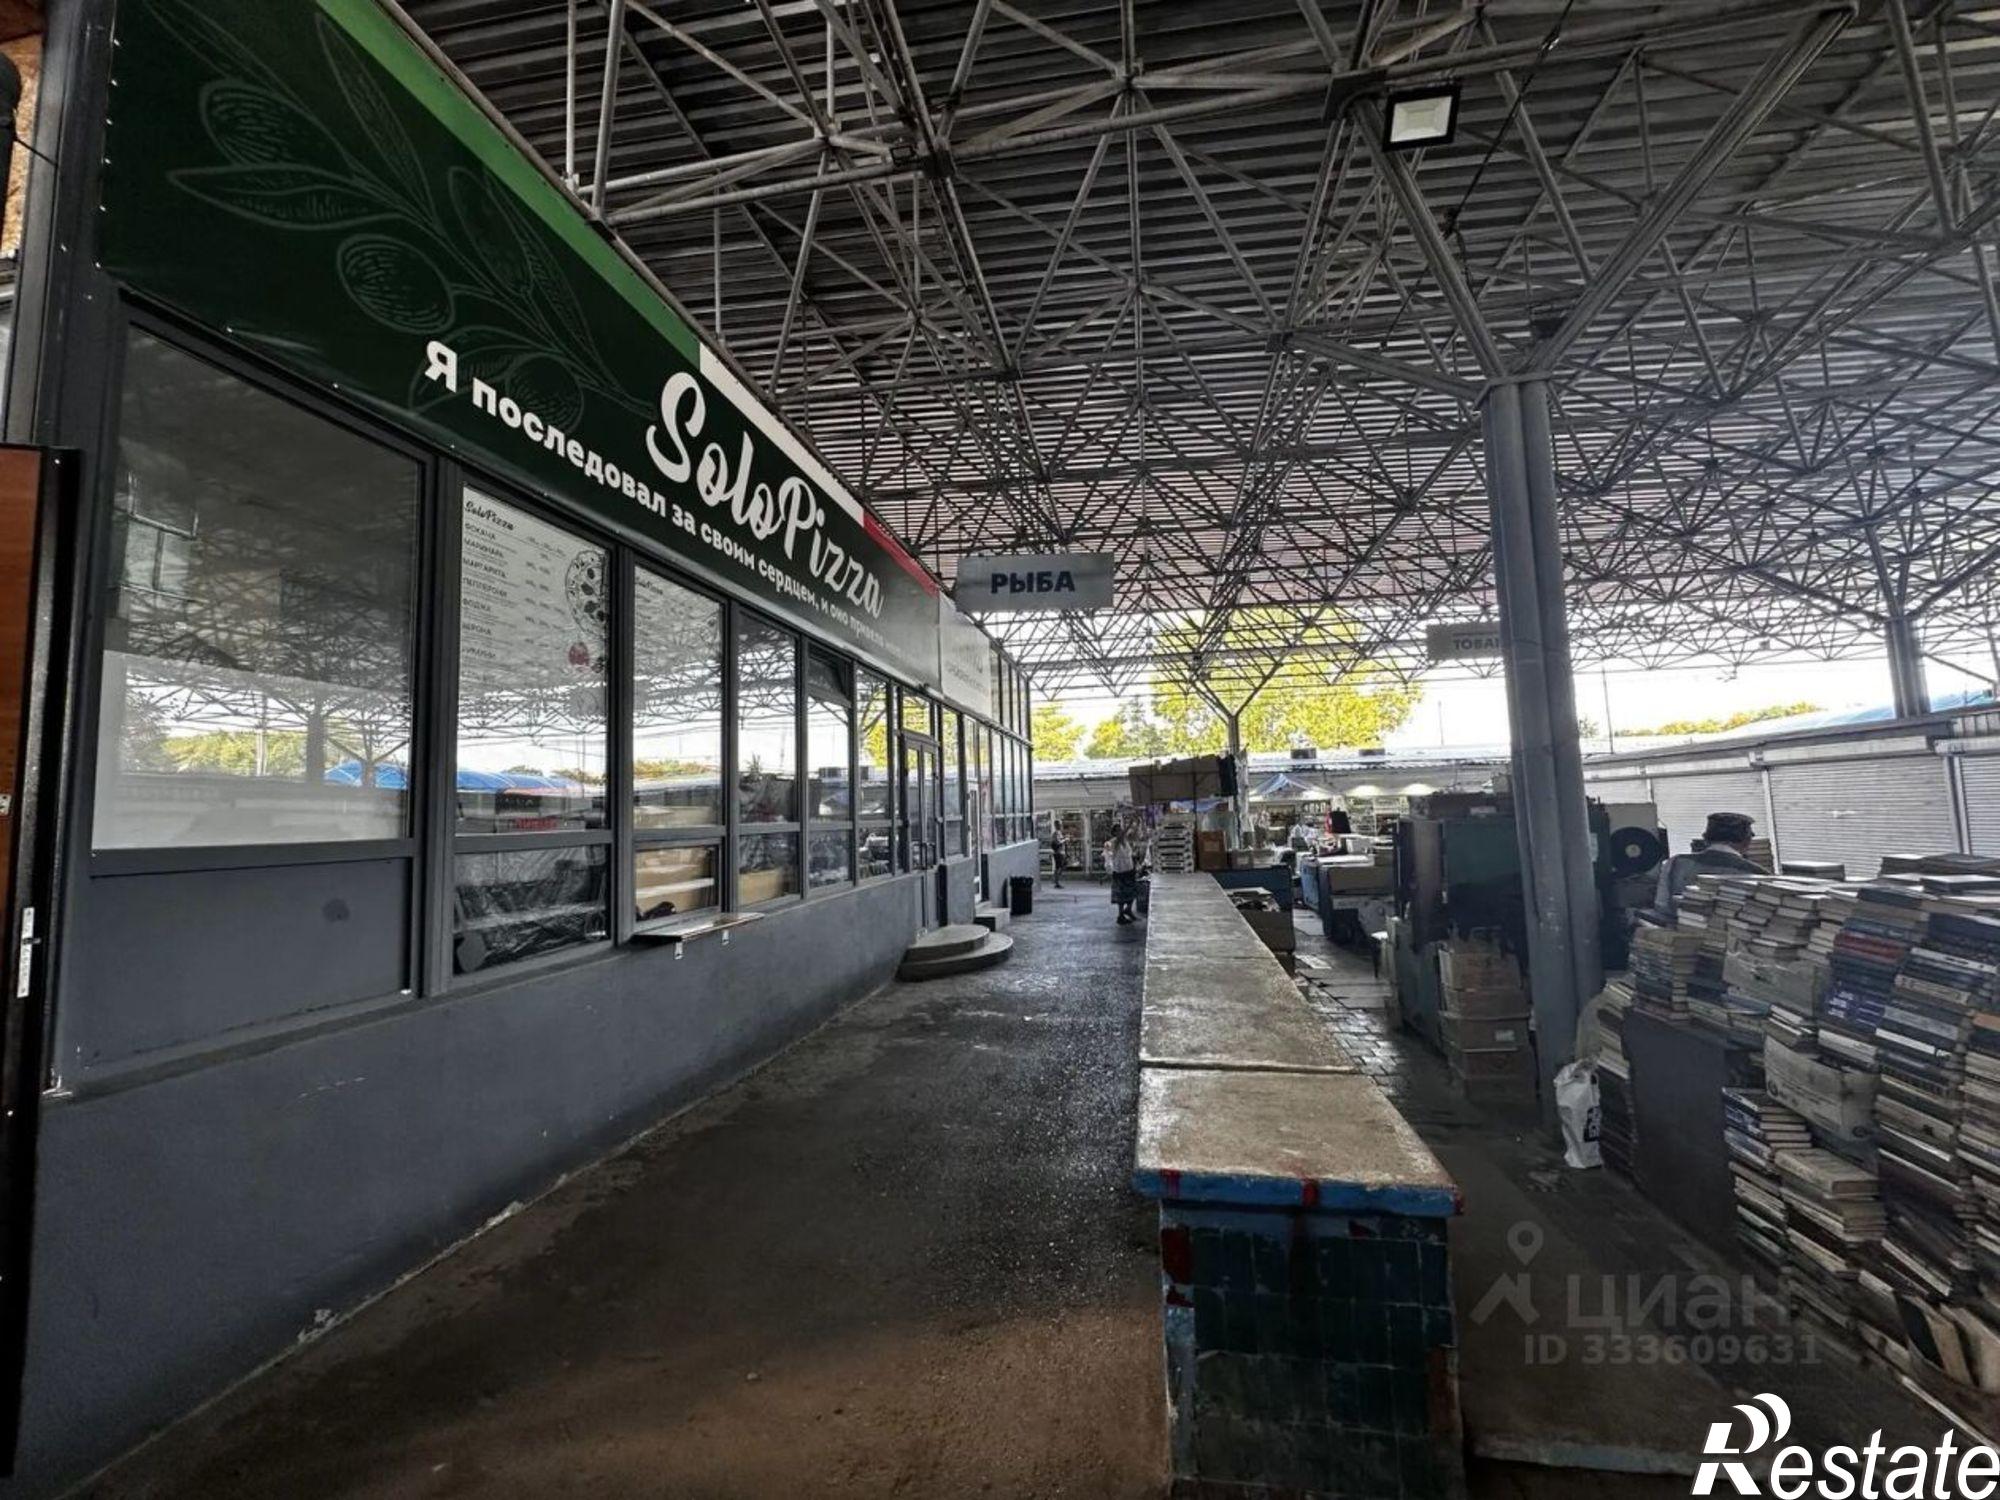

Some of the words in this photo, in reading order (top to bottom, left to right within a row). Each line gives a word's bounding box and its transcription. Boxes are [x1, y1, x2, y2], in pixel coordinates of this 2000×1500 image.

[424, 340, 458, 393] Я
[472, 376, 667, 518] последовал
[671, 503, 696, 537] за
[700, 522, 755, 571] своим
[758, 558, 820, 611] сердцем,
[821, 597, 829, 615] и
[645, 371, 885, 619] SoloPizza
[991, 570, 1076, 595] РЫБА
